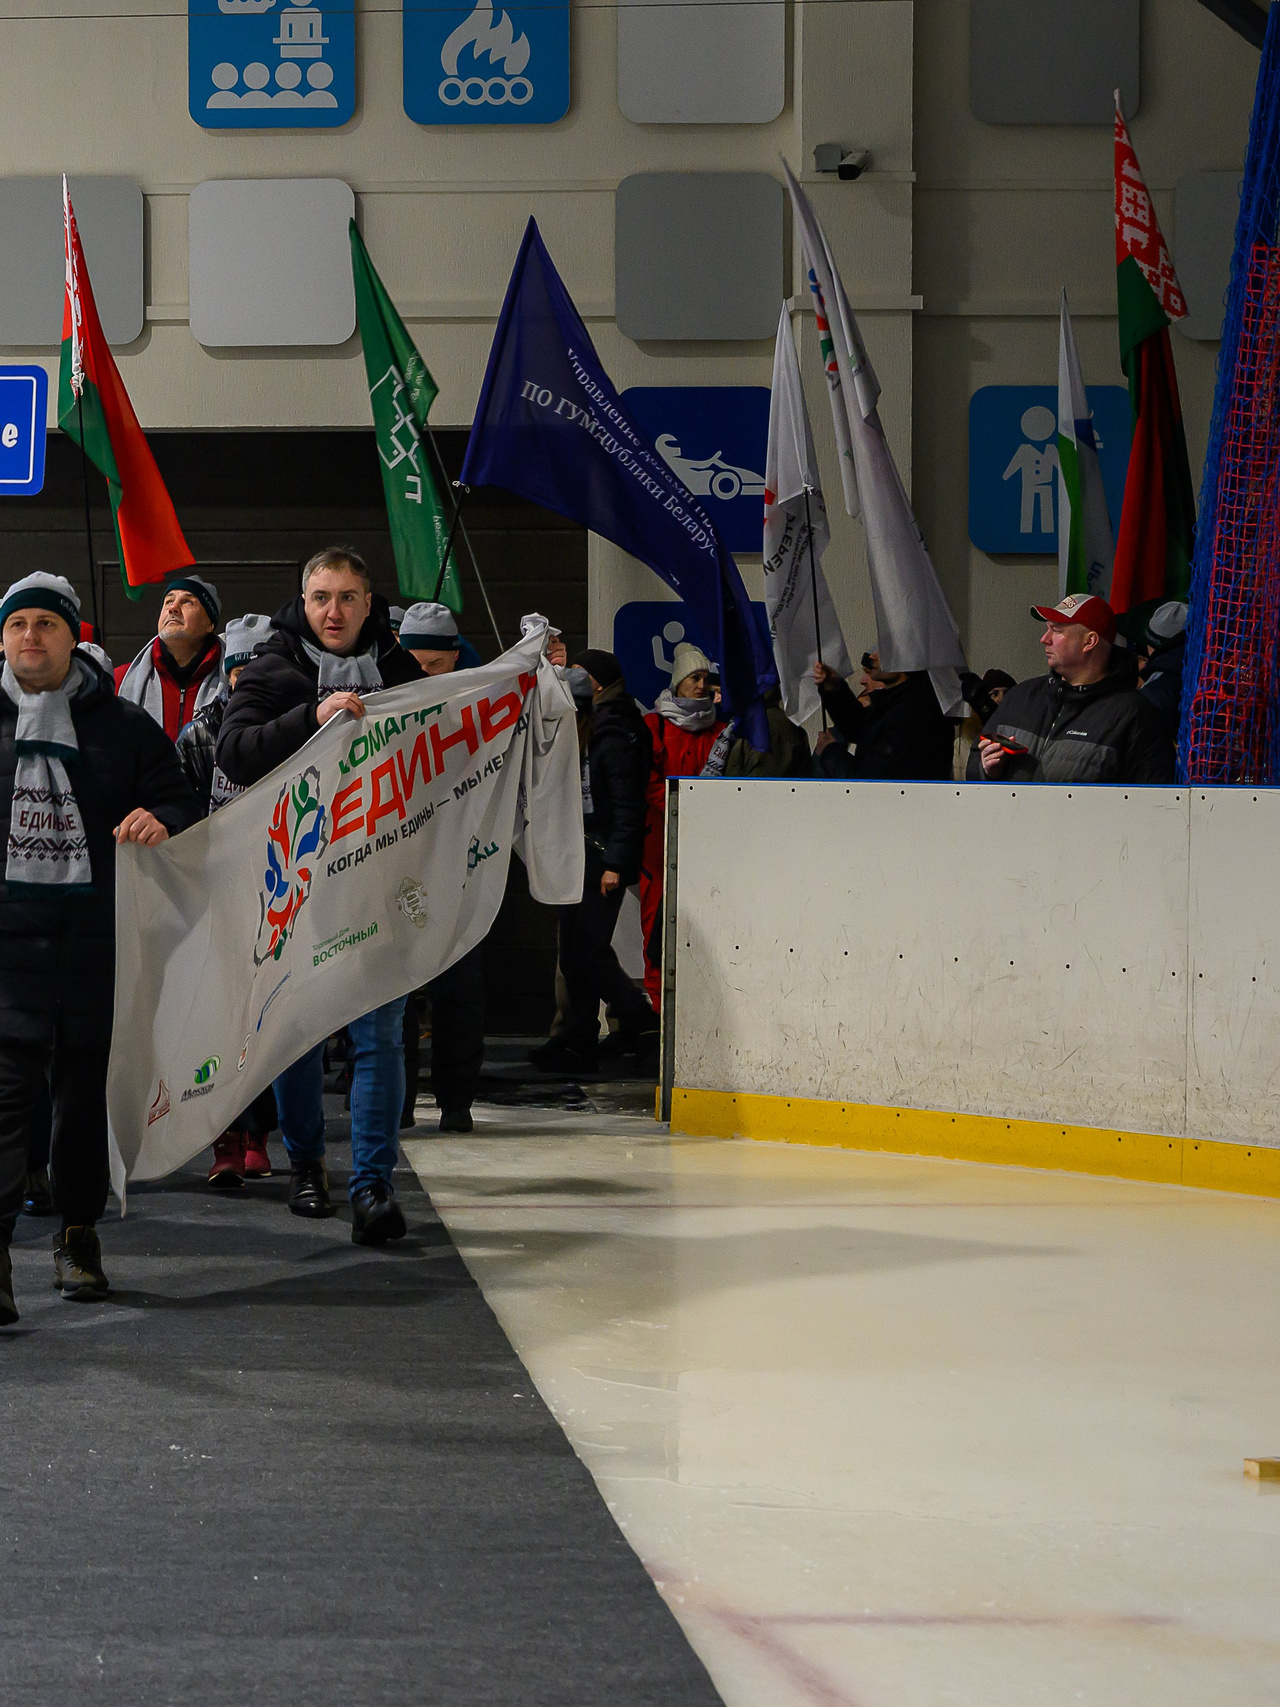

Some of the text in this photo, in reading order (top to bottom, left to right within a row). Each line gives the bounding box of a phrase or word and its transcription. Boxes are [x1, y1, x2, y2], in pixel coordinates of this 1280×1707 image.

[519, 380, 553, 407] ПО
[327, 843, 373, 878] КОГДА
[375, 829, 399, 852] МЫ
[401, 801, 435, 840] ЕДИНЫ
[452, 769, 482, 801] МЫ
[312, 920, 379, 967] ВОСТОЧНЫЙ
